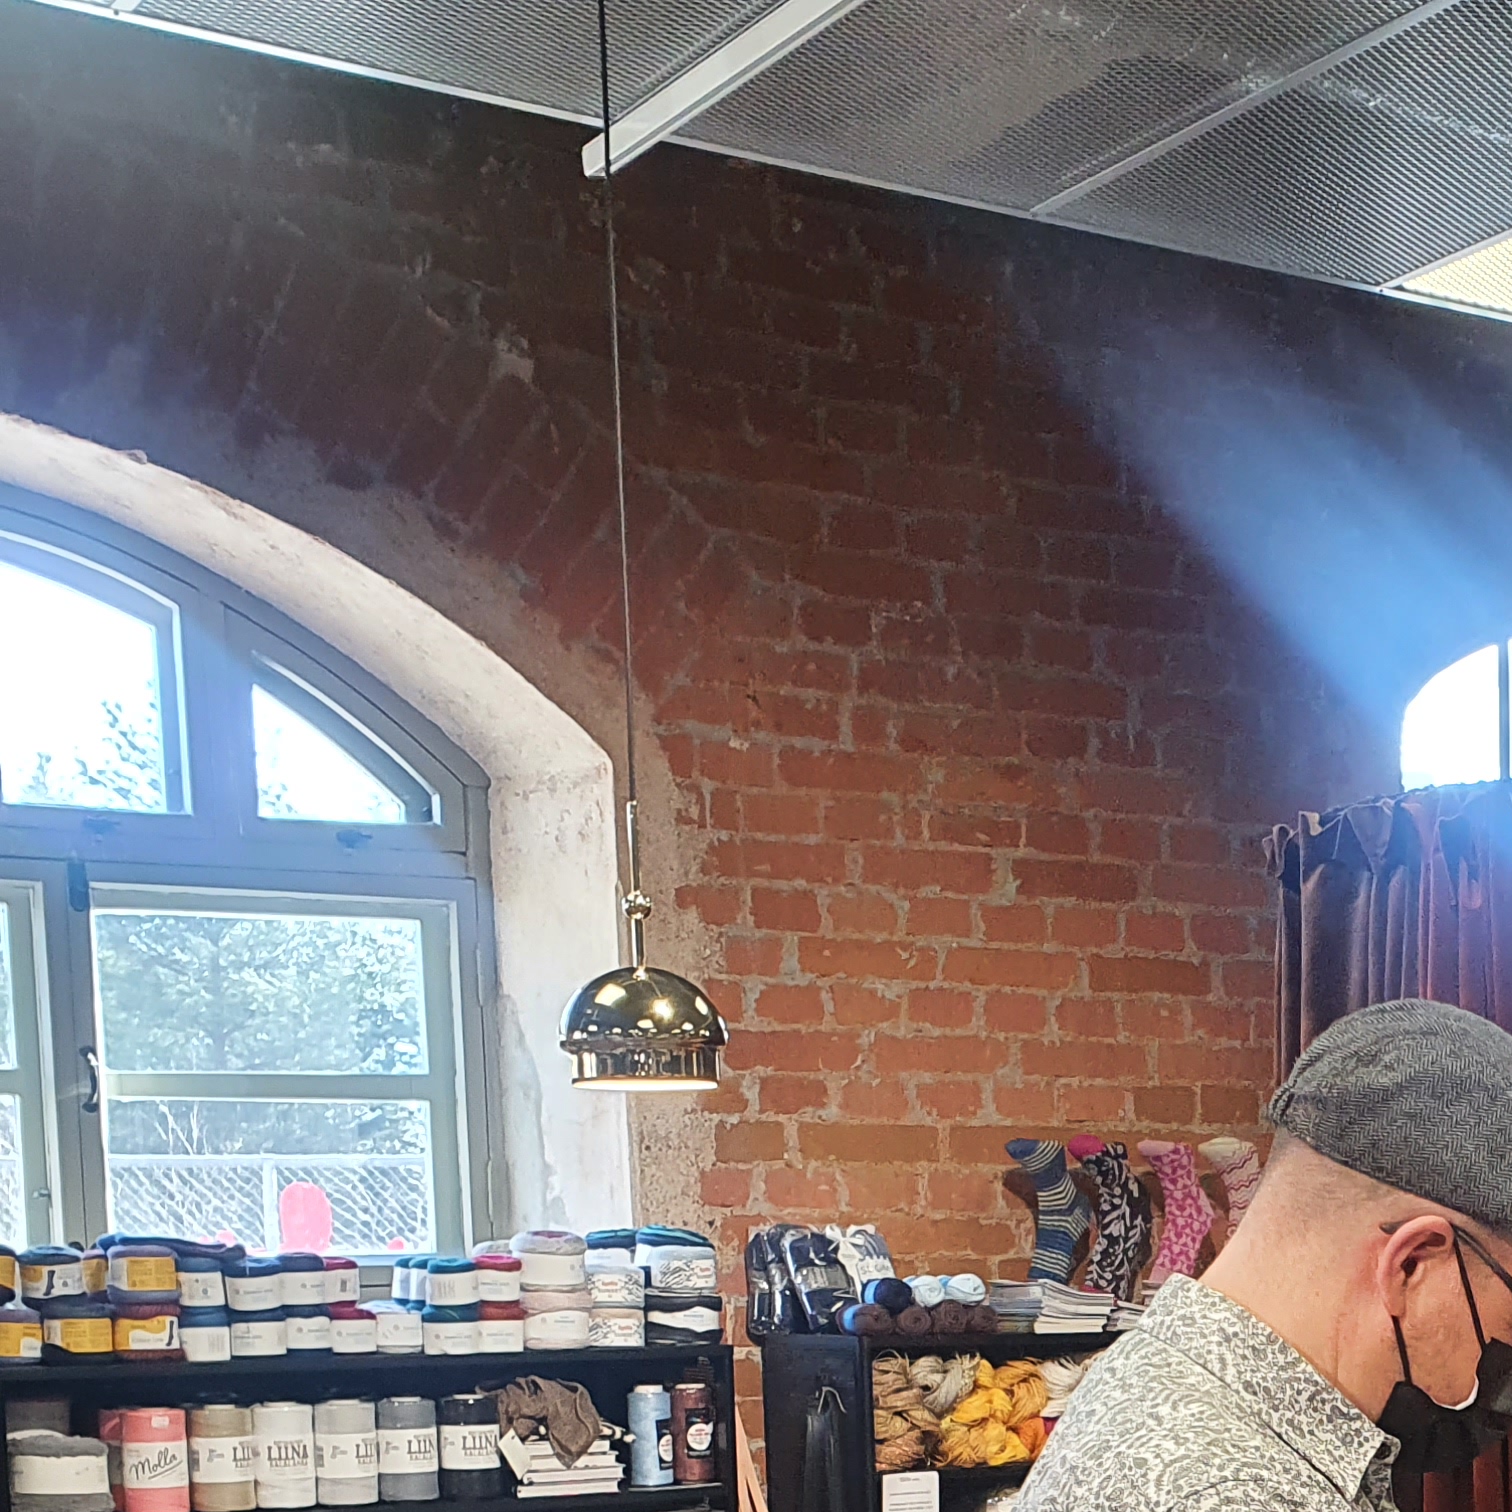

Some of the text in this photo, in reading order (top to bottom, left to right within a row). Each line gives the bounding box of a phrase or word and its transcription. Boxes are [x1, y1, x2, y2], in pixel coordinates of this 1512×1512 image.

[267, 1444, 309, 1461] LIINA
[407, 1438, 434, 1454] LIIN
[129, 1447, 178, 1480] Molla
